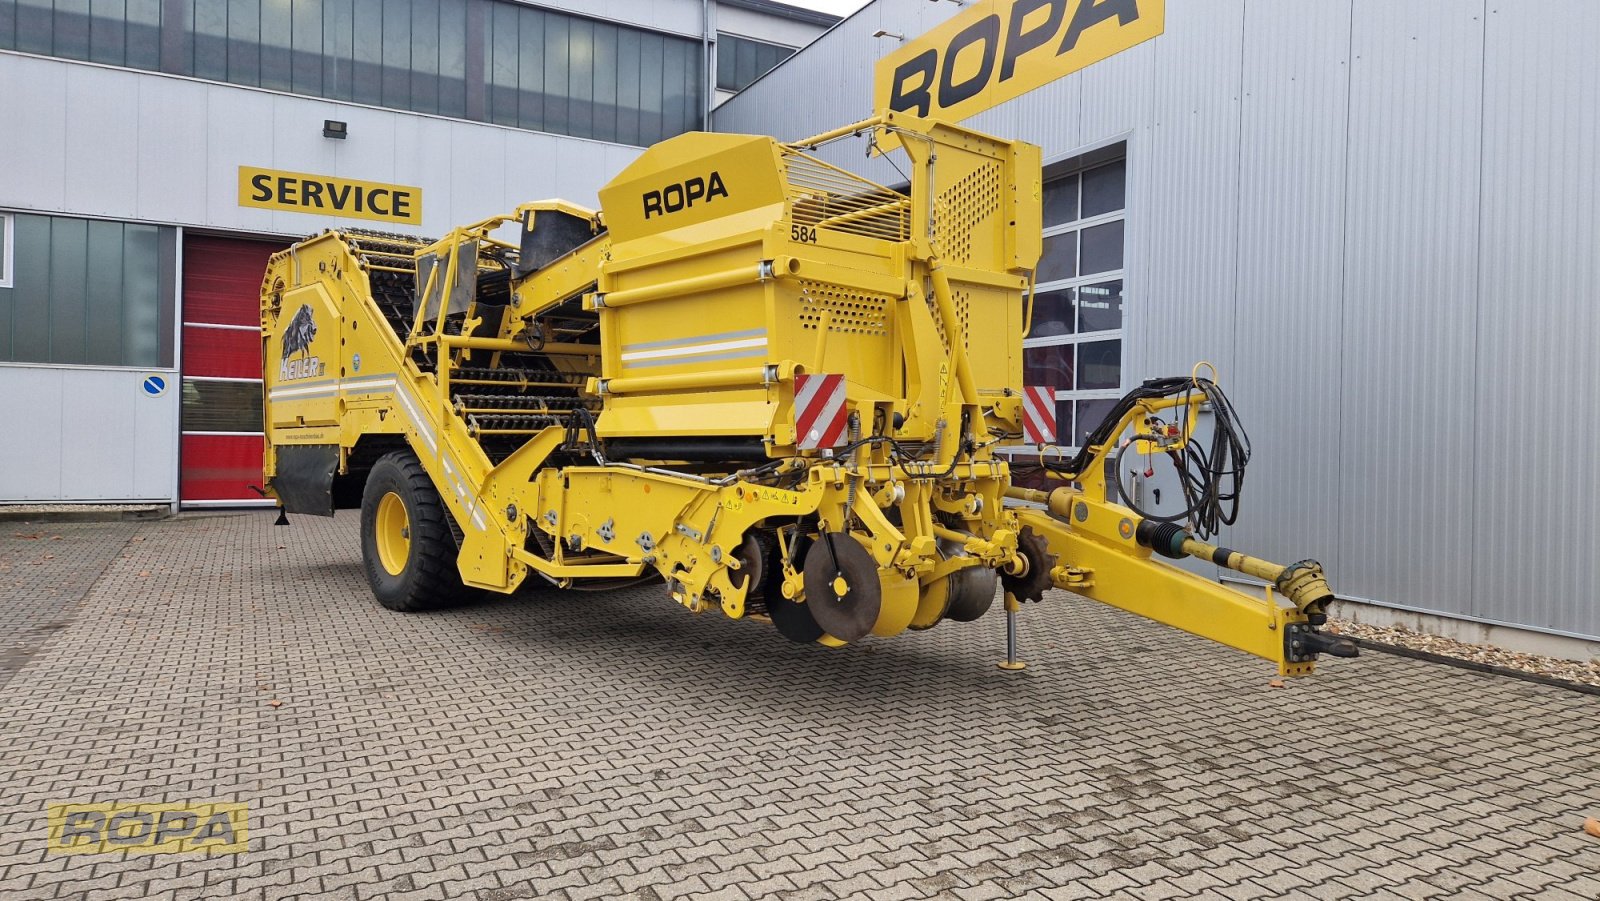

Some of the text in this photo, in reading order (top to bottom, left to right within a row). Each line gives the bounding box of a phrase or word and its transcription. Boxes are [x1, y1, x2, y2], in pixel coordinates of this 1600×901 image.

[251, 174, 411, 218] SERVICE
[642, 170, 729, 220] ROPA
[791, 224, 818, 244] 584
[279, 356, 319, 381] KEILER
